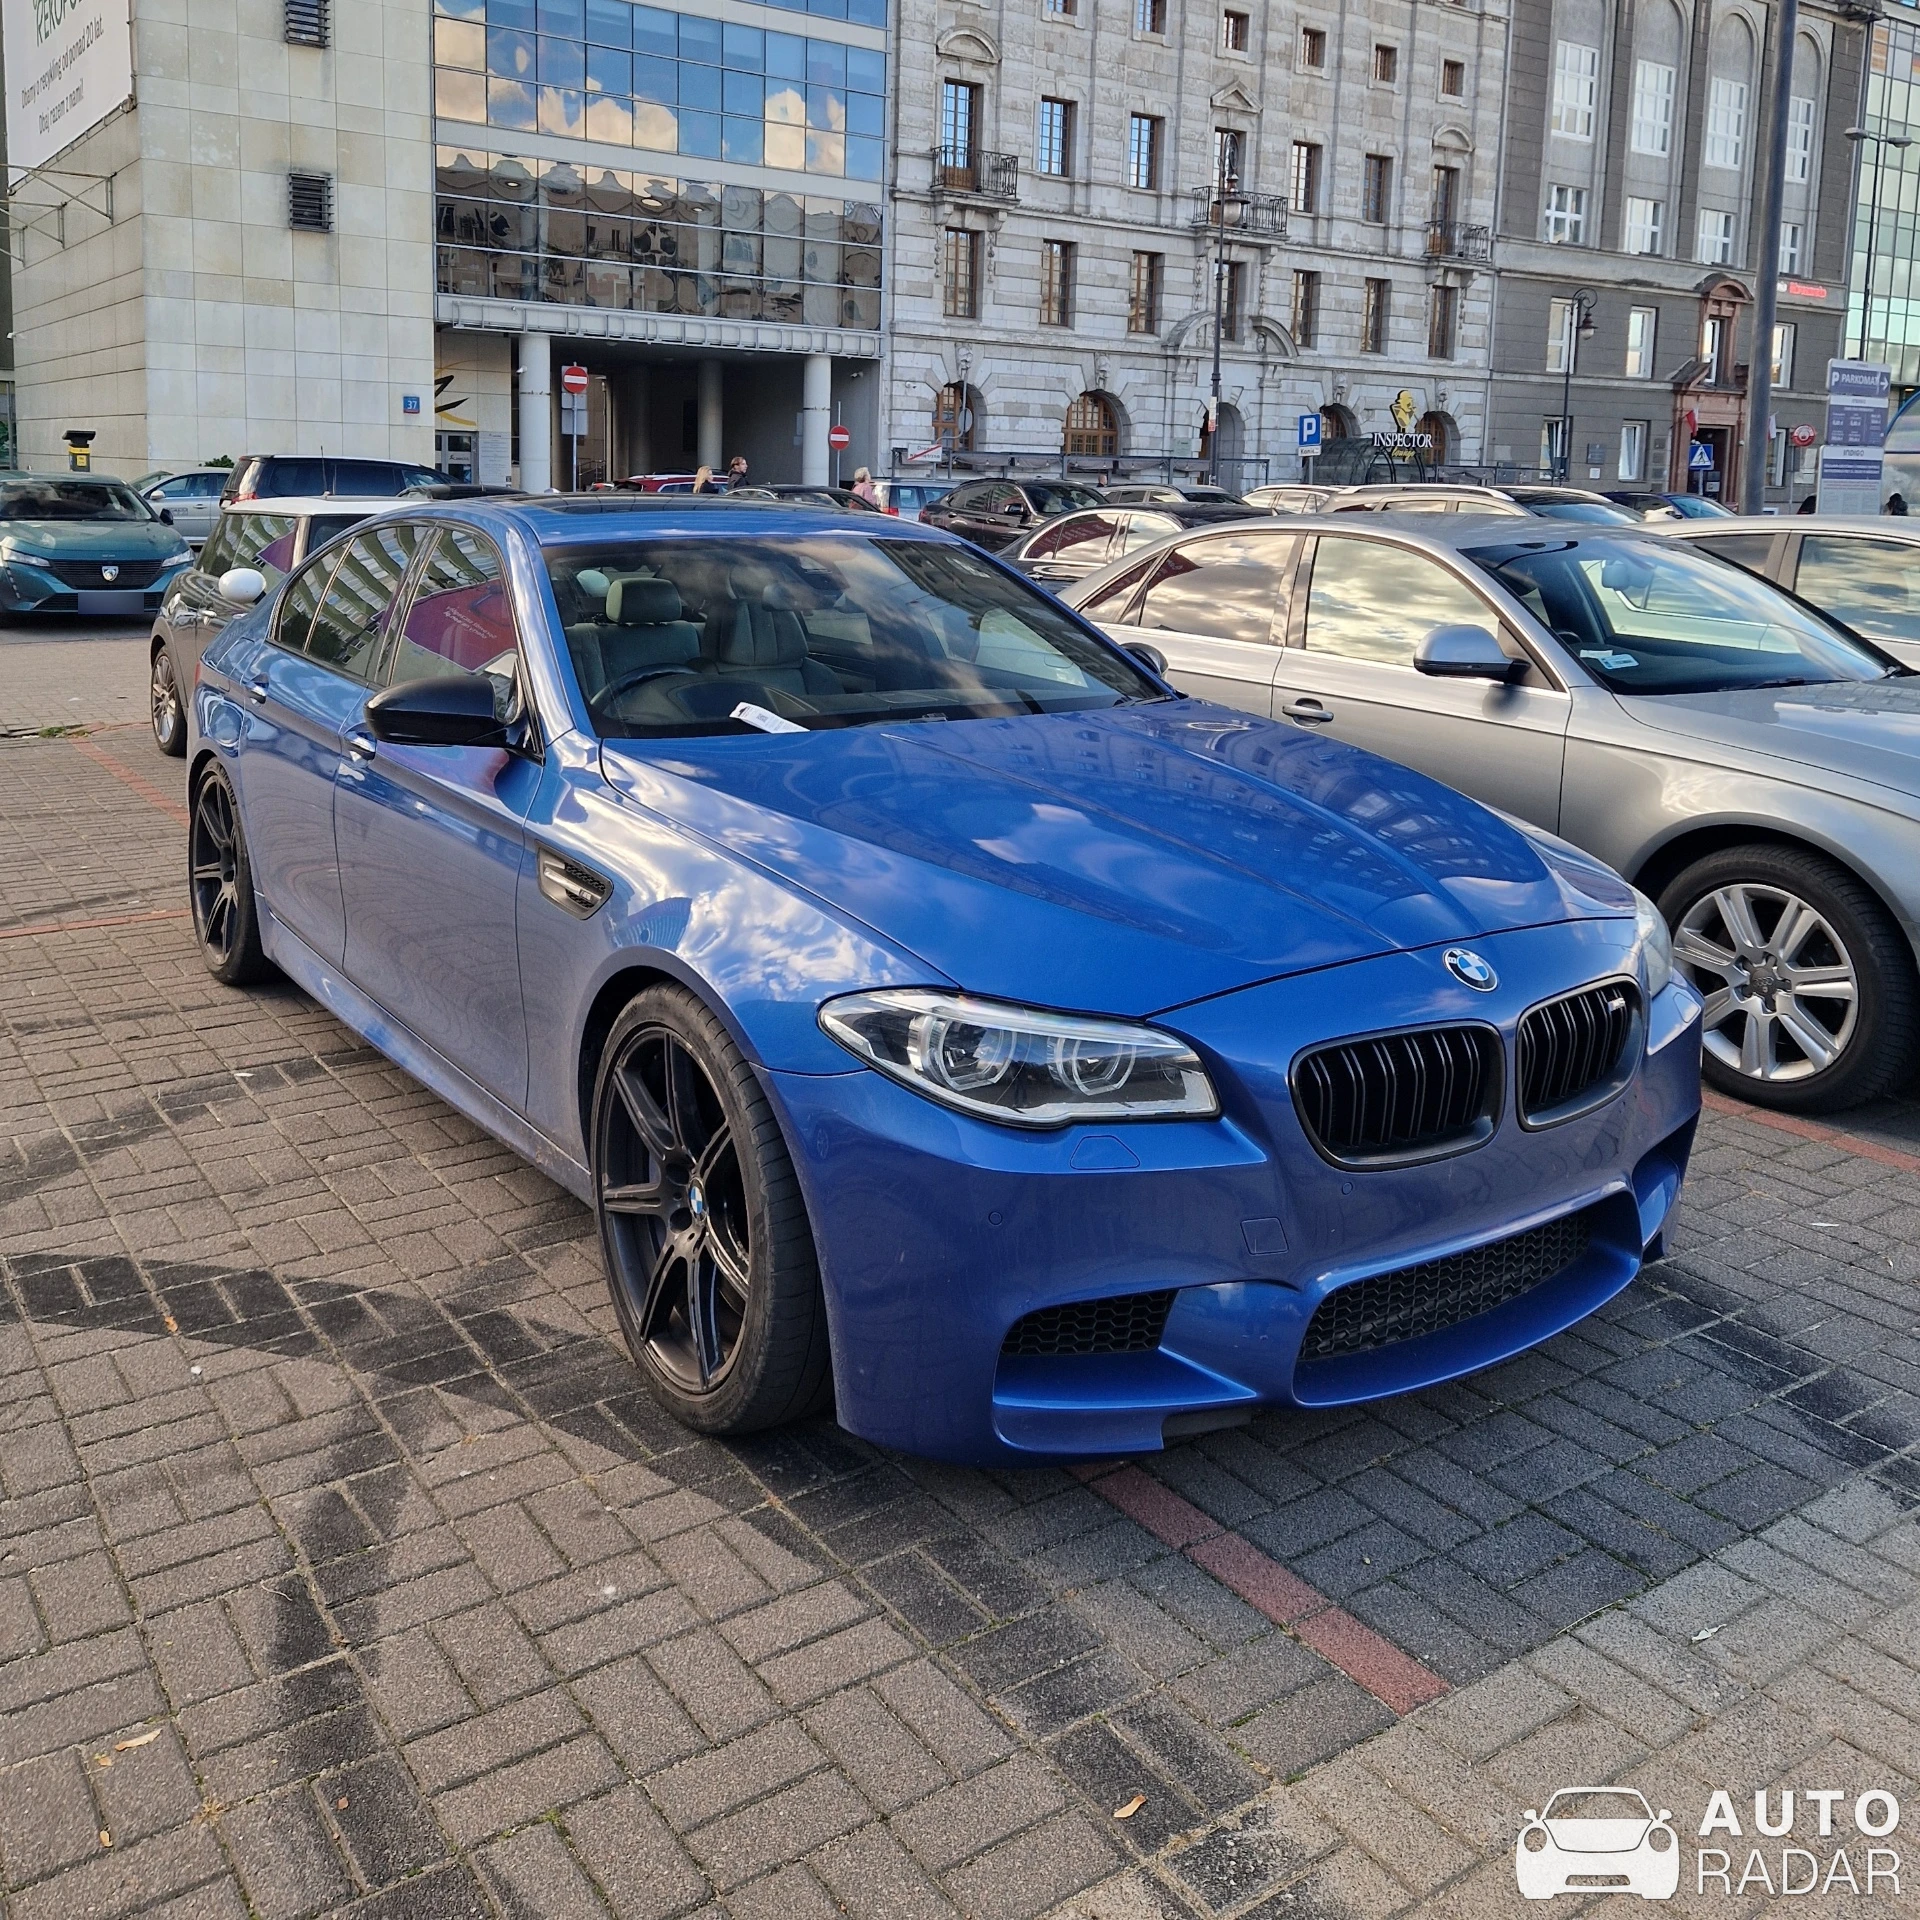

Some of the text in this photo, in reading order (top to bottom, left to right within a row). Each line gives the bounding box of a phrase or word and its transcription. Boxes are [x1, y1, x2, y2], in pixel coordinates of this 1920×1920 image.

[40, 57, 62, 92] recykling
[62, 45, 69, 71] od
[69, 28, 85, 70] ponad
[86, 21, 94, 48] 20
[94, 14, 104, 40] lat.
[50, 99, 65, 126] razem
[65, 96, 69, 113] z
[1841, 373, 1879, 387] PARKOMAT
[407, 400, 418, 410] 37
[1303, 418, 1316, 442] P
[1374, 433, 1433, 448] INSPECTOR
